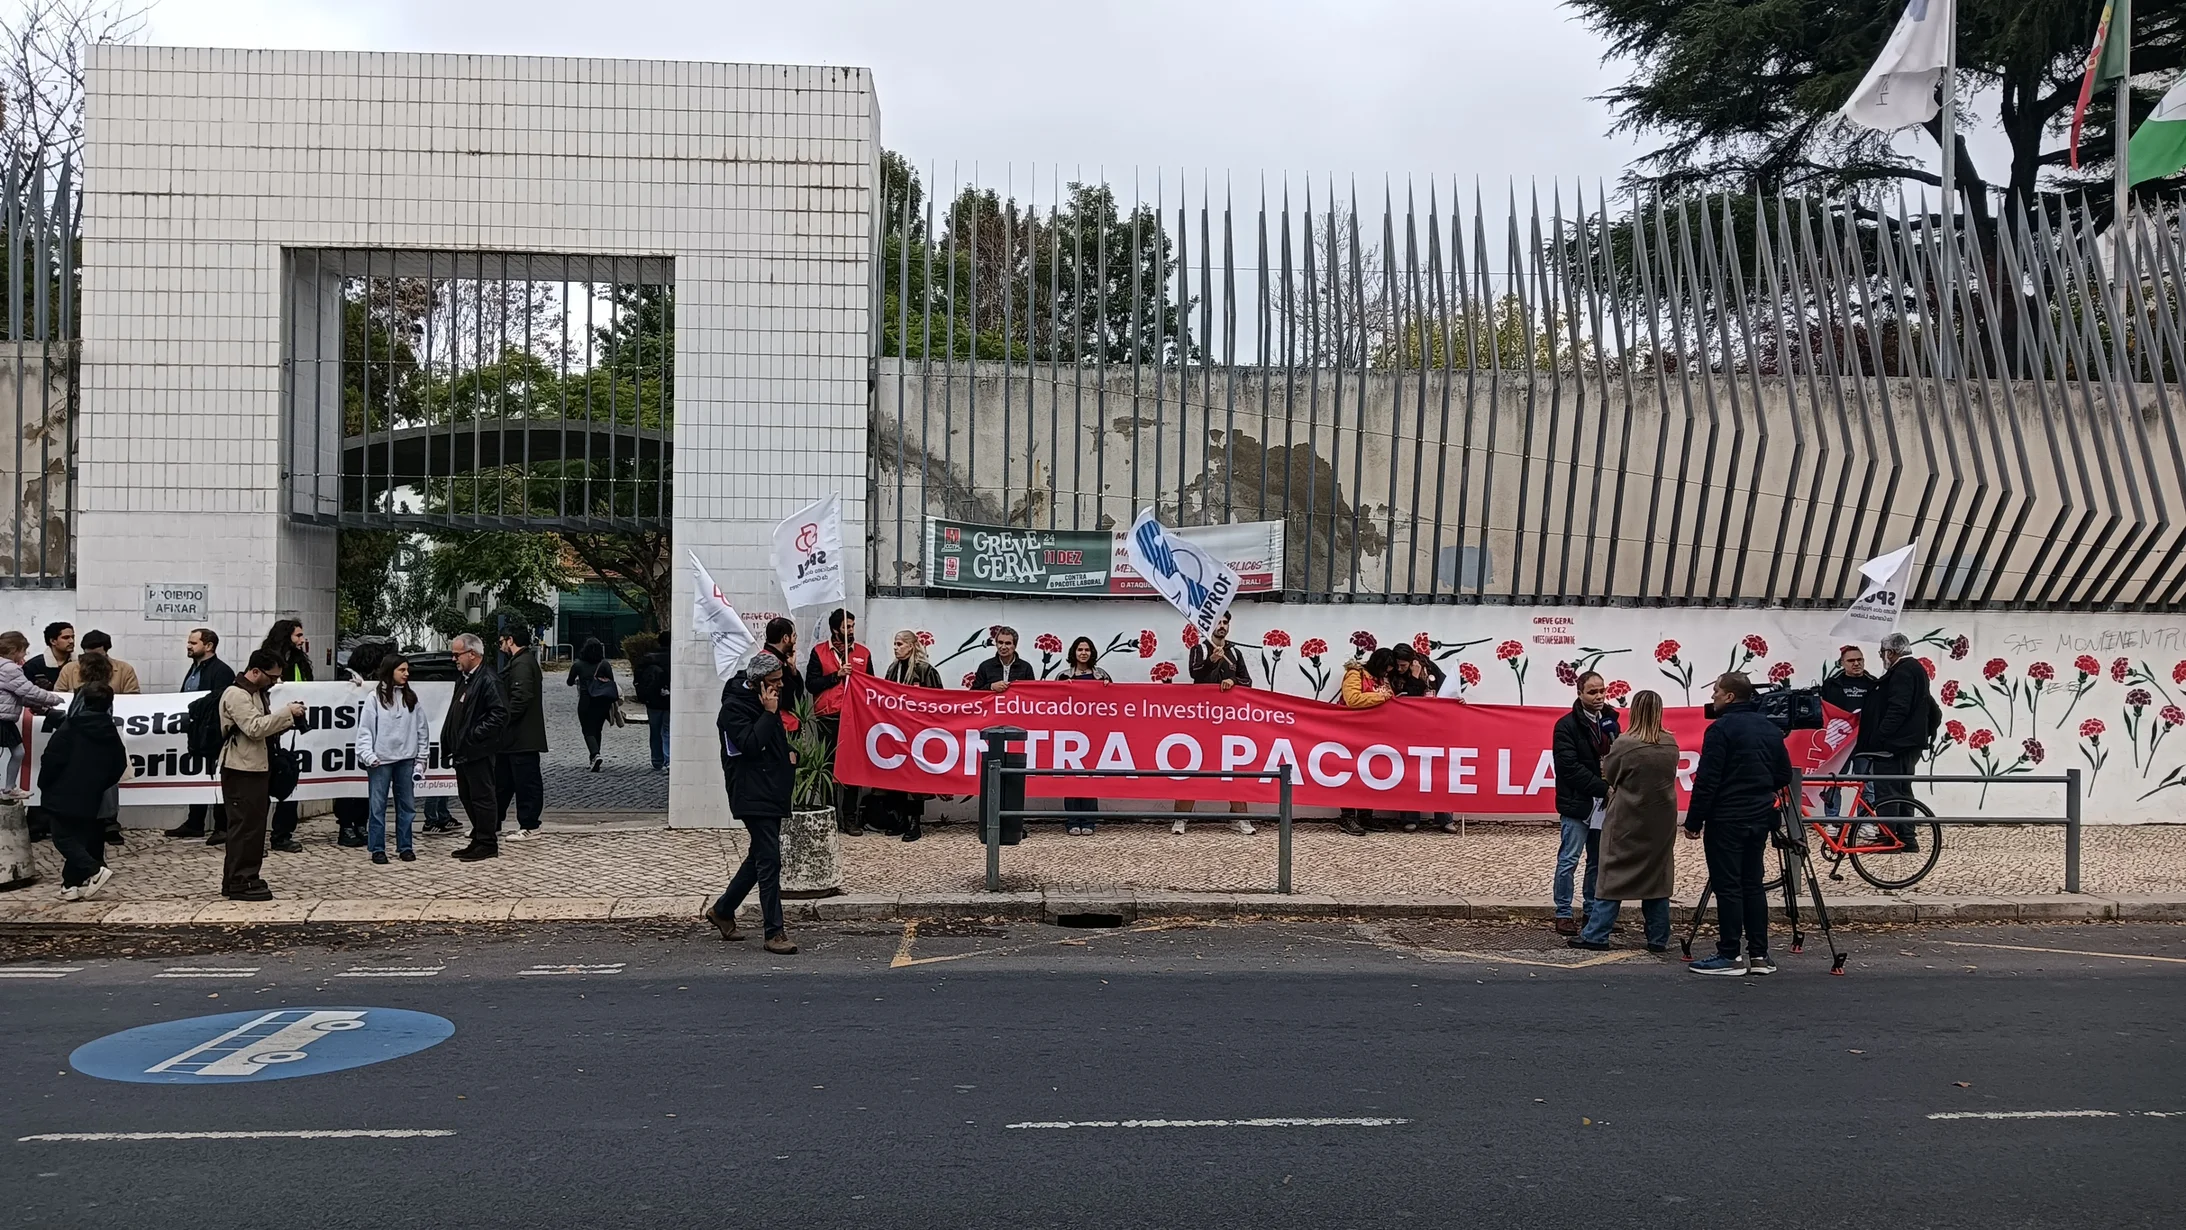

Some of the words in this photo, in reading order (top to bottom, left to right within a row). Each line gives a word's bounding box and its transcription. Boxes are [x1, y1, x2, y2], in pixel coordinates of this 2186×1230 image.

[972, 531, 1041, 559] GREVE
[1043, 533, 1055, 542] 24
[1043, 550, 1055, 565] 11
[1057, 550, 1082, 566] DEZ
[972, 551, 1047, 584] GERAL
[1076, 578, 1102, 586] LABORAL
[149, 590, 203, 601] POIBIDO
[1198, 572, 1231, 632] ENPROF
[155, 603, 197, 613] AFIXAR
[1532, 616, 1553, 625] GREVE
[1554, 616, 1575, 625] GERAL
[865, 688, 988, 717] Professores,
[995, 695, 1118, 717] Educadores
[1124, 702, 1136, 717] e
[1142, 699, 1296, 725] Investigadores
[1155, 732, 1203, 781] O
[1220, 735, 1479, 794] PACOTE
